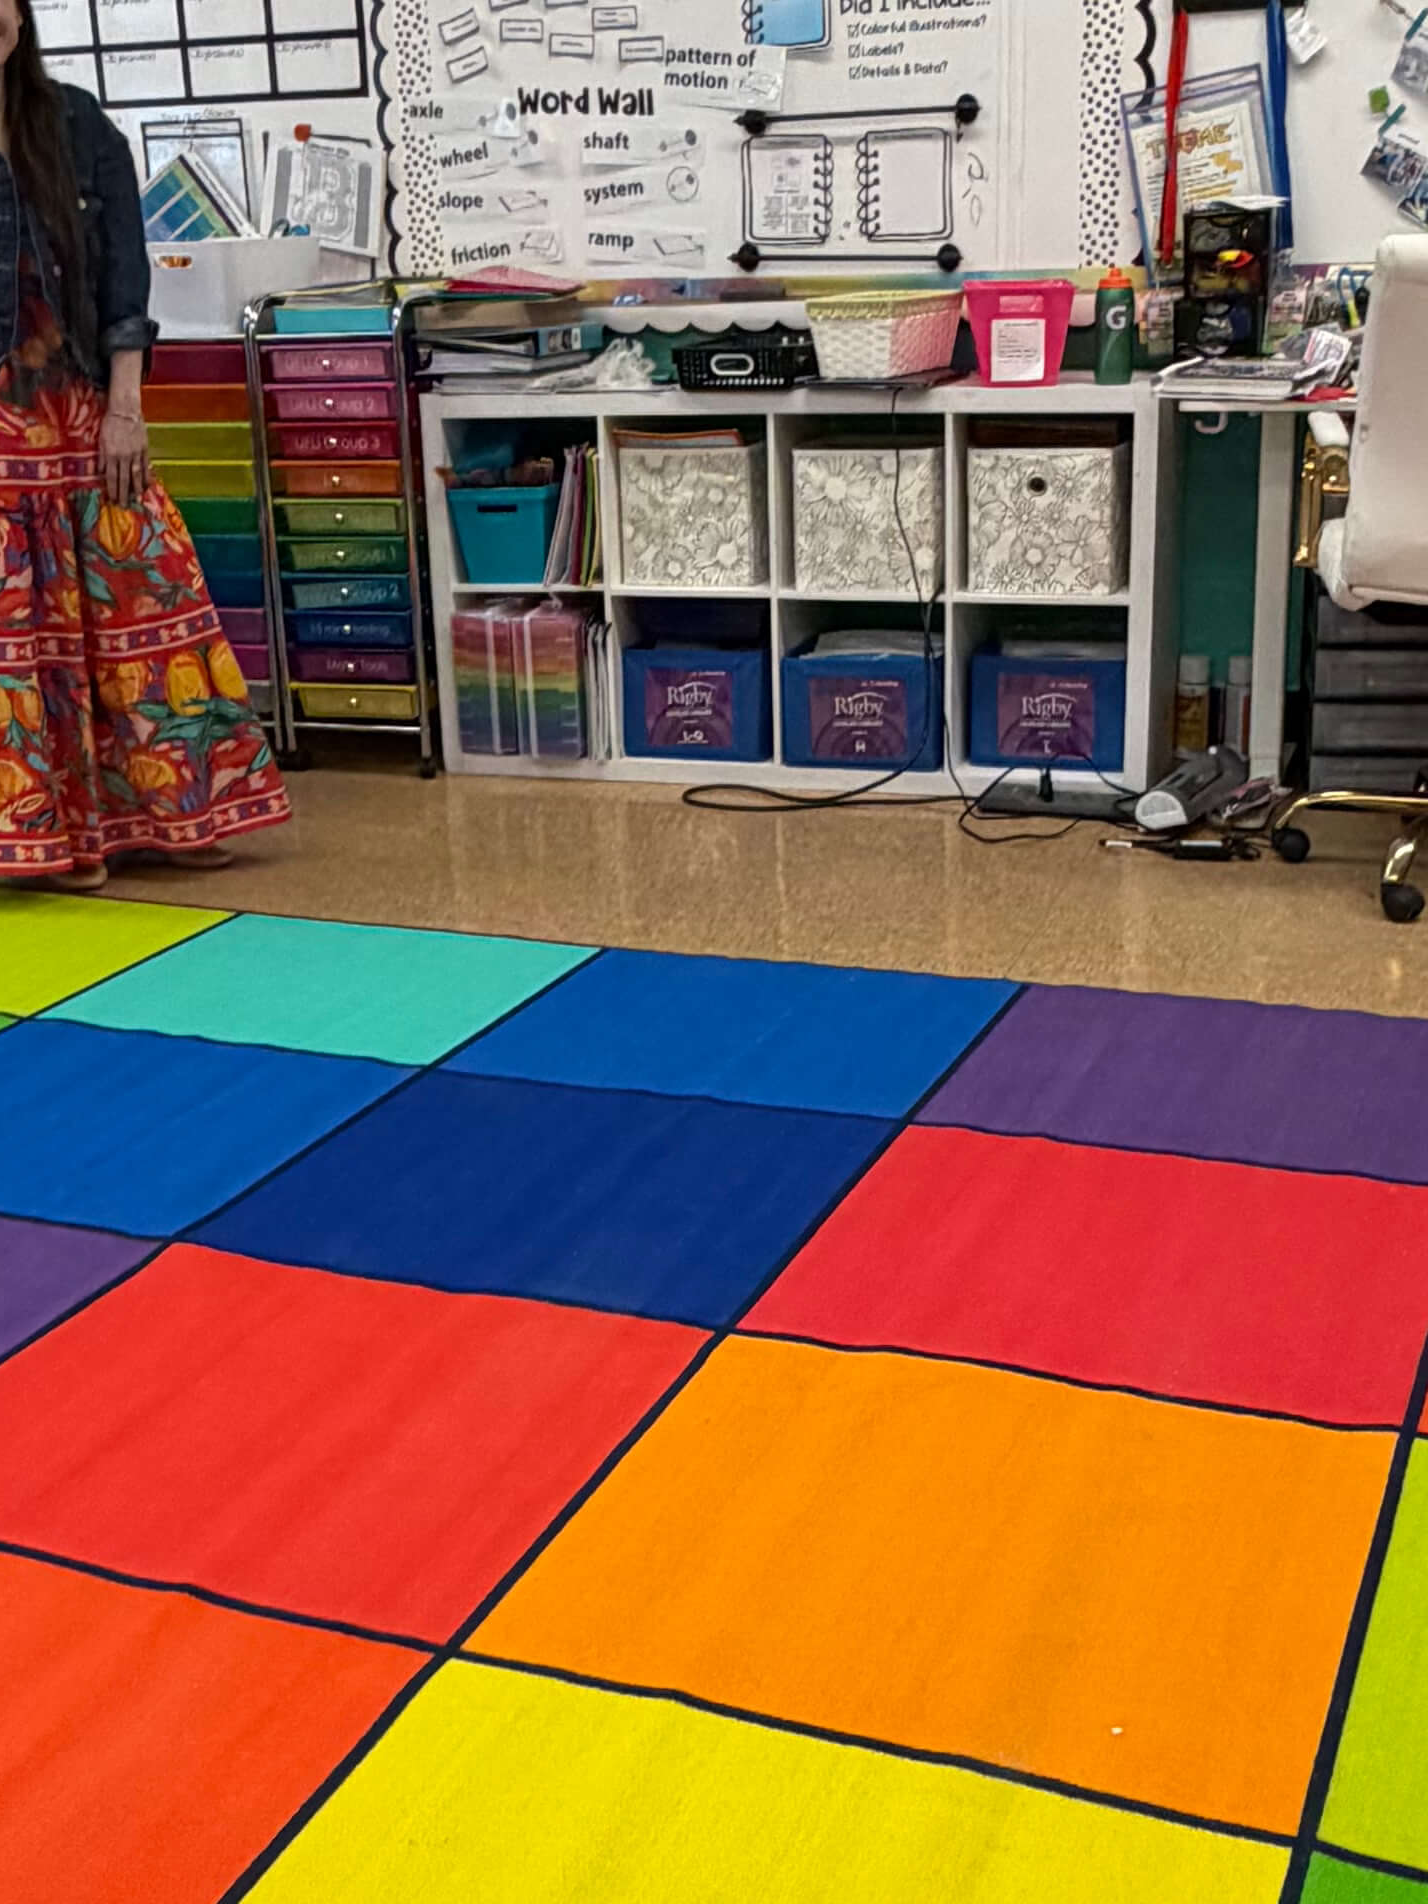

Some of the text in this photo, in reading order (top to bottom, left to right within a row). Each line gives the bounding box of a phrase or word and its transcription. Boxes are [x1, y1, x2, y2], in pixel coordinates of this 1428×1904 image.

[860, 19, 907, 38] Colorful
[664, 47, 757, 69] pattern of
[861, 42, 905, 58] Labels?
[663, 69, 729, 90] motion
[862, 60, 949, 79] Details & Data?
[409, 102, 444, 120] axle
[517, 87, 655, 117] Word Wall
[582, 130, 630, 151] shaft
[1145, 118, 1234, 160] TEME
[439, 141, 490, 169] wheel
[438, 192, 485, 212] slope
[583, 179, 645, 203] system
[587, 229, 635, 252] ramp
[450, 240, 511, 266] friction
[1105, 305, 1127, 330] G
[324, 434, 369, 451] Goup
[666, 682, 714, 707] Rigby
[834, 694, 886, 718] Rigby
[1021, 695, 1073, 721] Rigby
